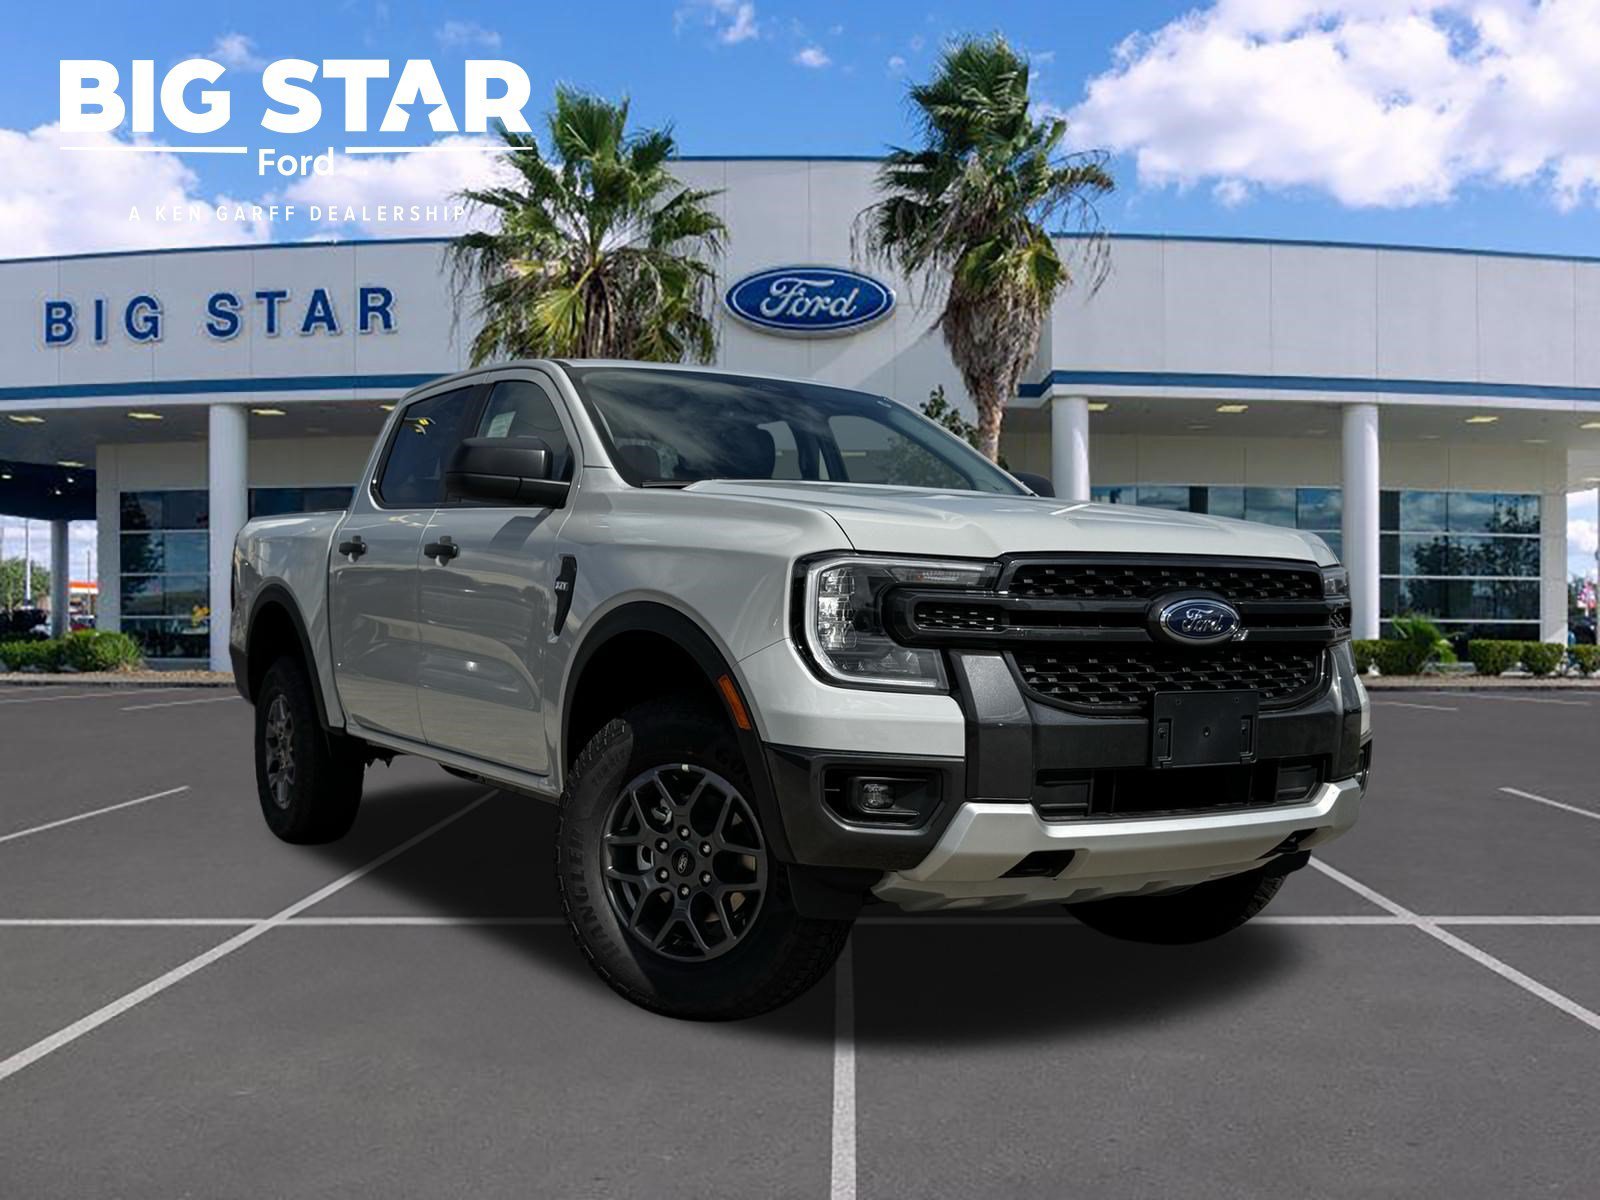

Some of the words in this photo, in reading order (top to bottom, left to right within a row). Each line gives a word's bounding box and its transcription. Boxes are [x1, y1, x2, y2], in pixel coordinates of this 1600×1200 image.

[44, 295, 164, 348] BIG
[205, 286, 398, 341] STAR
[759, 277, 859, 317] Ford
[1181, 608, 1223, 632] Ford
